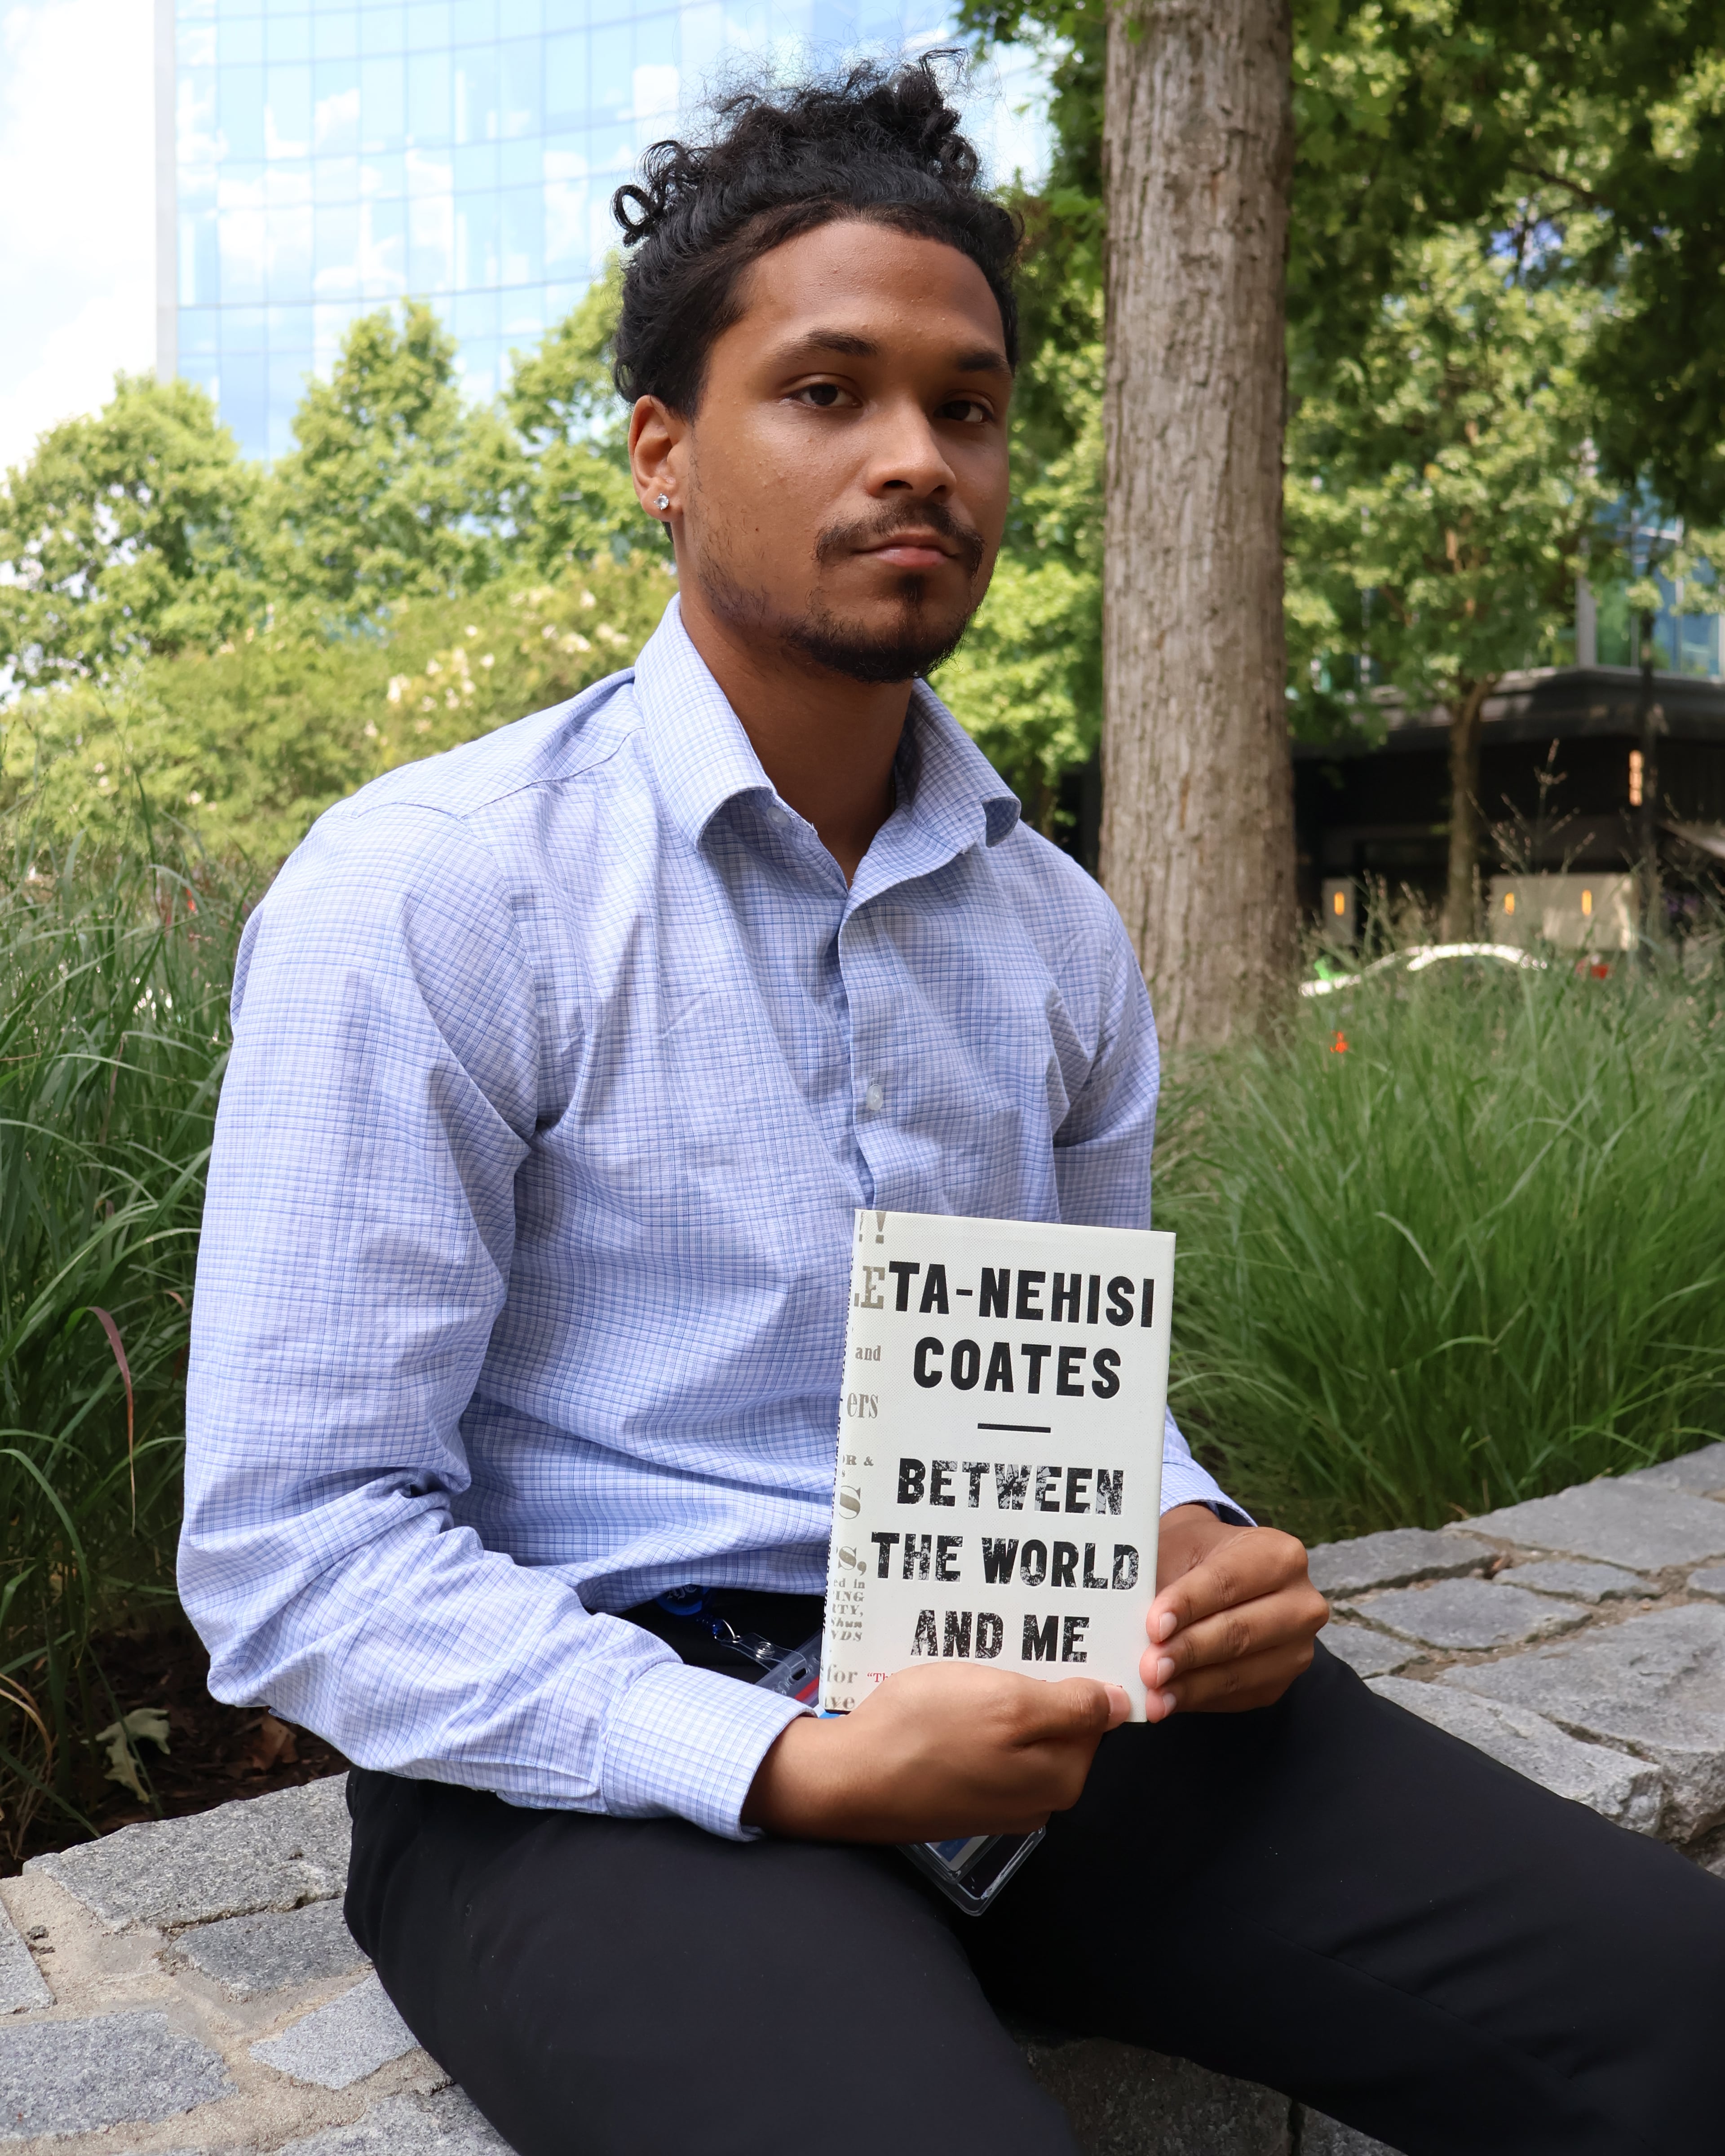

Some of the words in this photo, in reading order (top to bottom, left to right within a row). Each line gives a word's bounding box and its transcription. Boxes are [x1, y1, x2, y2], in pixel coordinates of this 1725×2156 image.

[889, 1261, 1154, 1328] TA-NEHISI
[855, 1345, 881, 1361] and
[913, 1337, 1121, 1399] COATES
[863, 1456, 874, 1467] &
[897, 1458, 1124, 1515] BETWEEN
[871, 1532, 964, 1582] THE
[981, 1537, 1140, 1590] WORLD
[854, 1578, 865, 1589] in
[910, 1609, 1004, 1659] AND
[1021, 1614, 1090, 1663] ME
